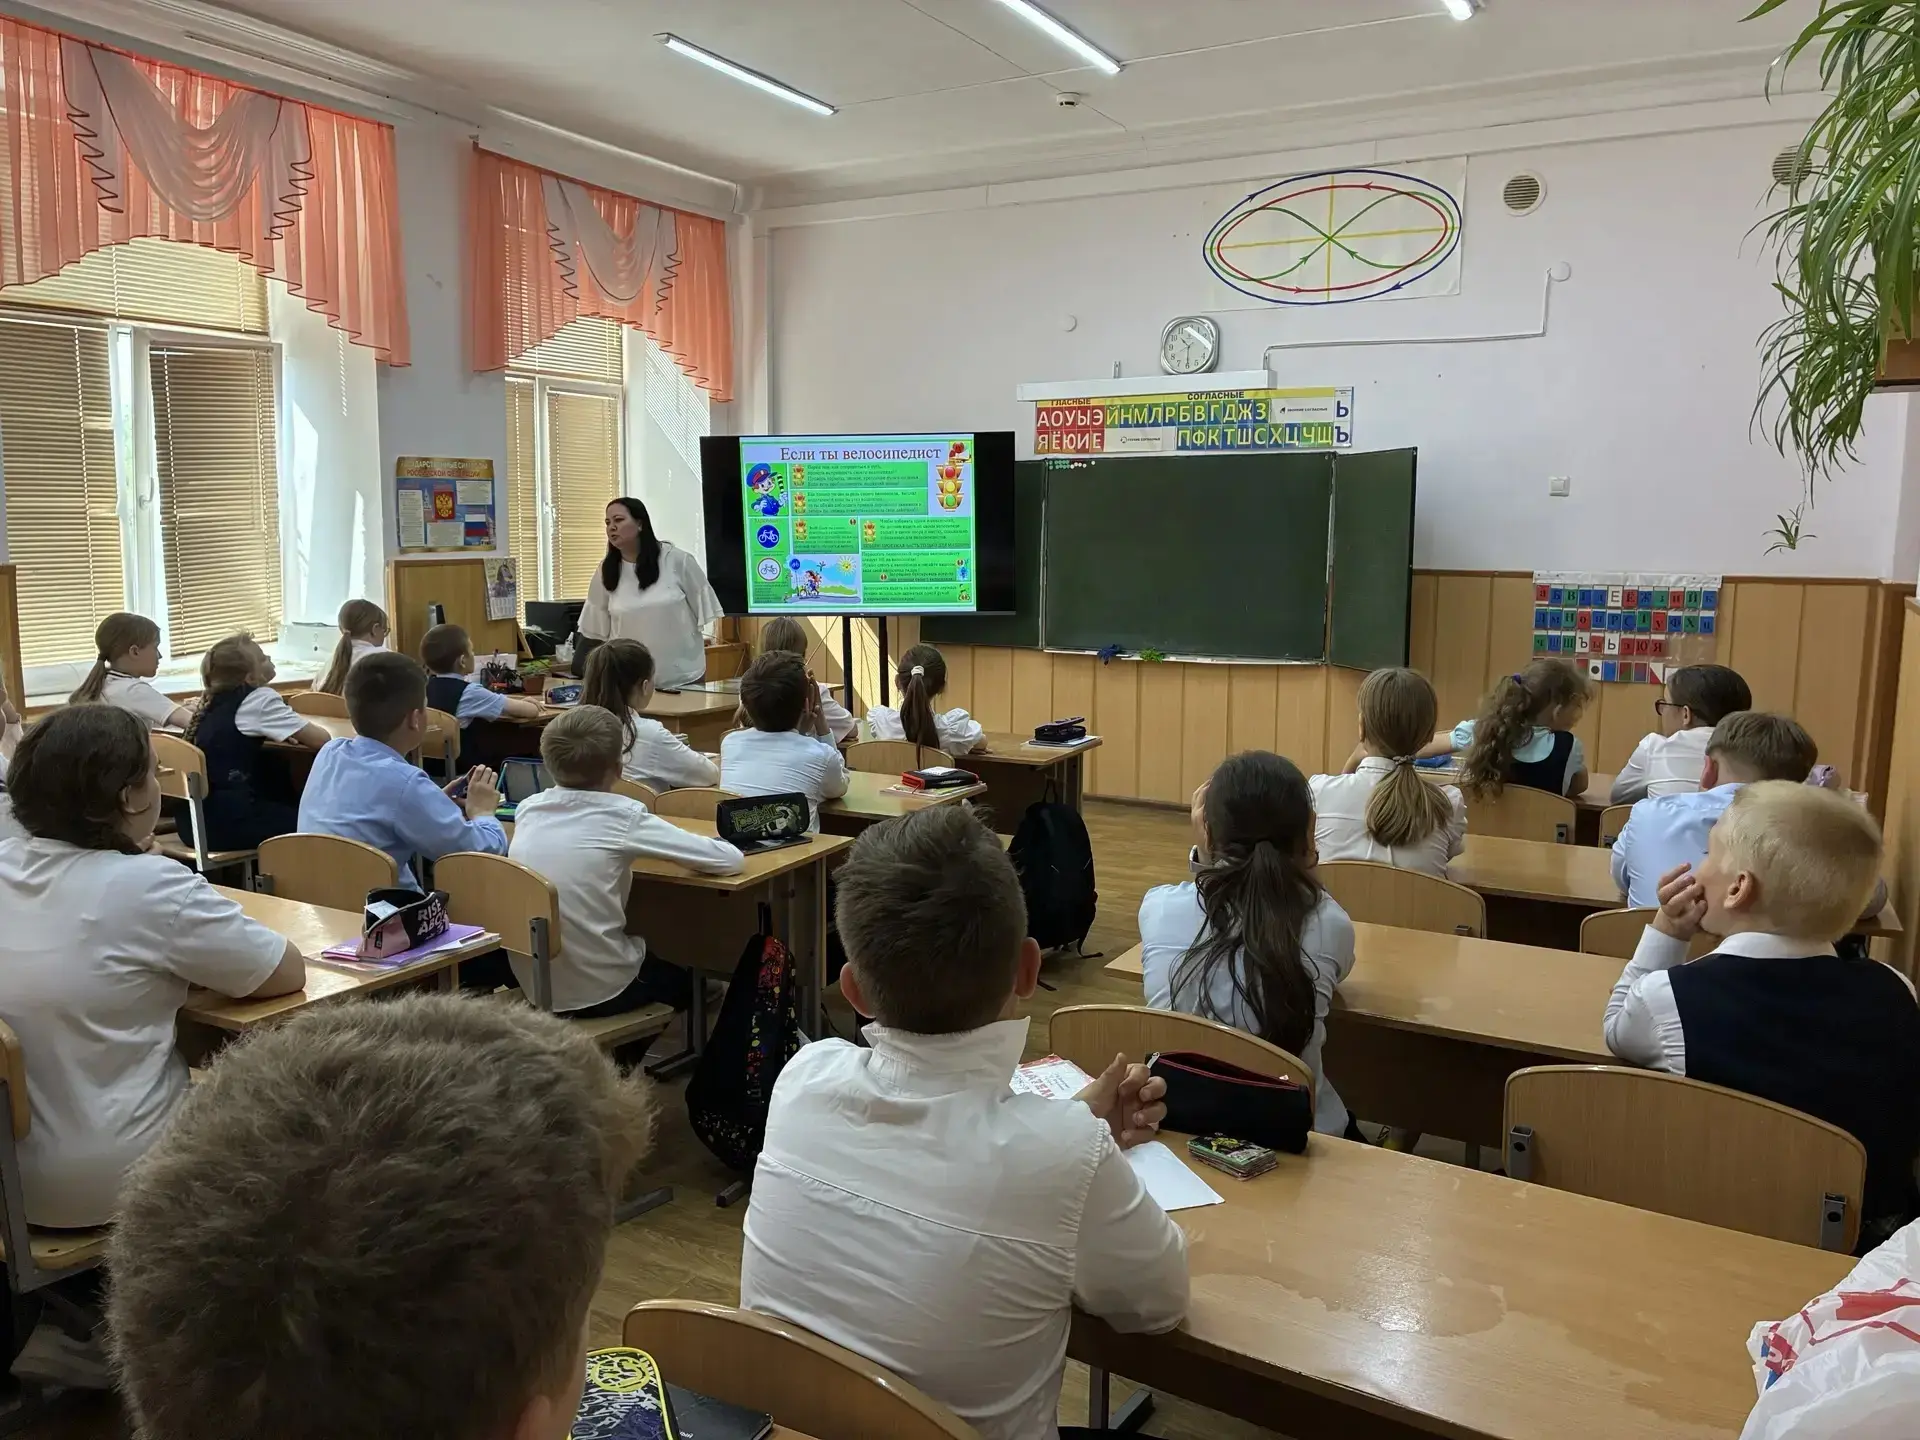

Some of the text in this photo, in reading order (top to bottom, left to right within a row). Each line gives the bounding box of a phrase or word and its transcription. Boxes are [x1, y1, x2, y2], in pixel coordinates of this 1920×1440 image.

[1178, 327, 1184, 335] 11
[1171, 334, 1178, 342] 10
[1187, 391, 1245, 400] СОГЛАСНЫЕ
[780, 448, 941, 461] Если ты велосипедист
[417, 898, 442, 921] RISE
[416, 908, 446, 936] ABO
